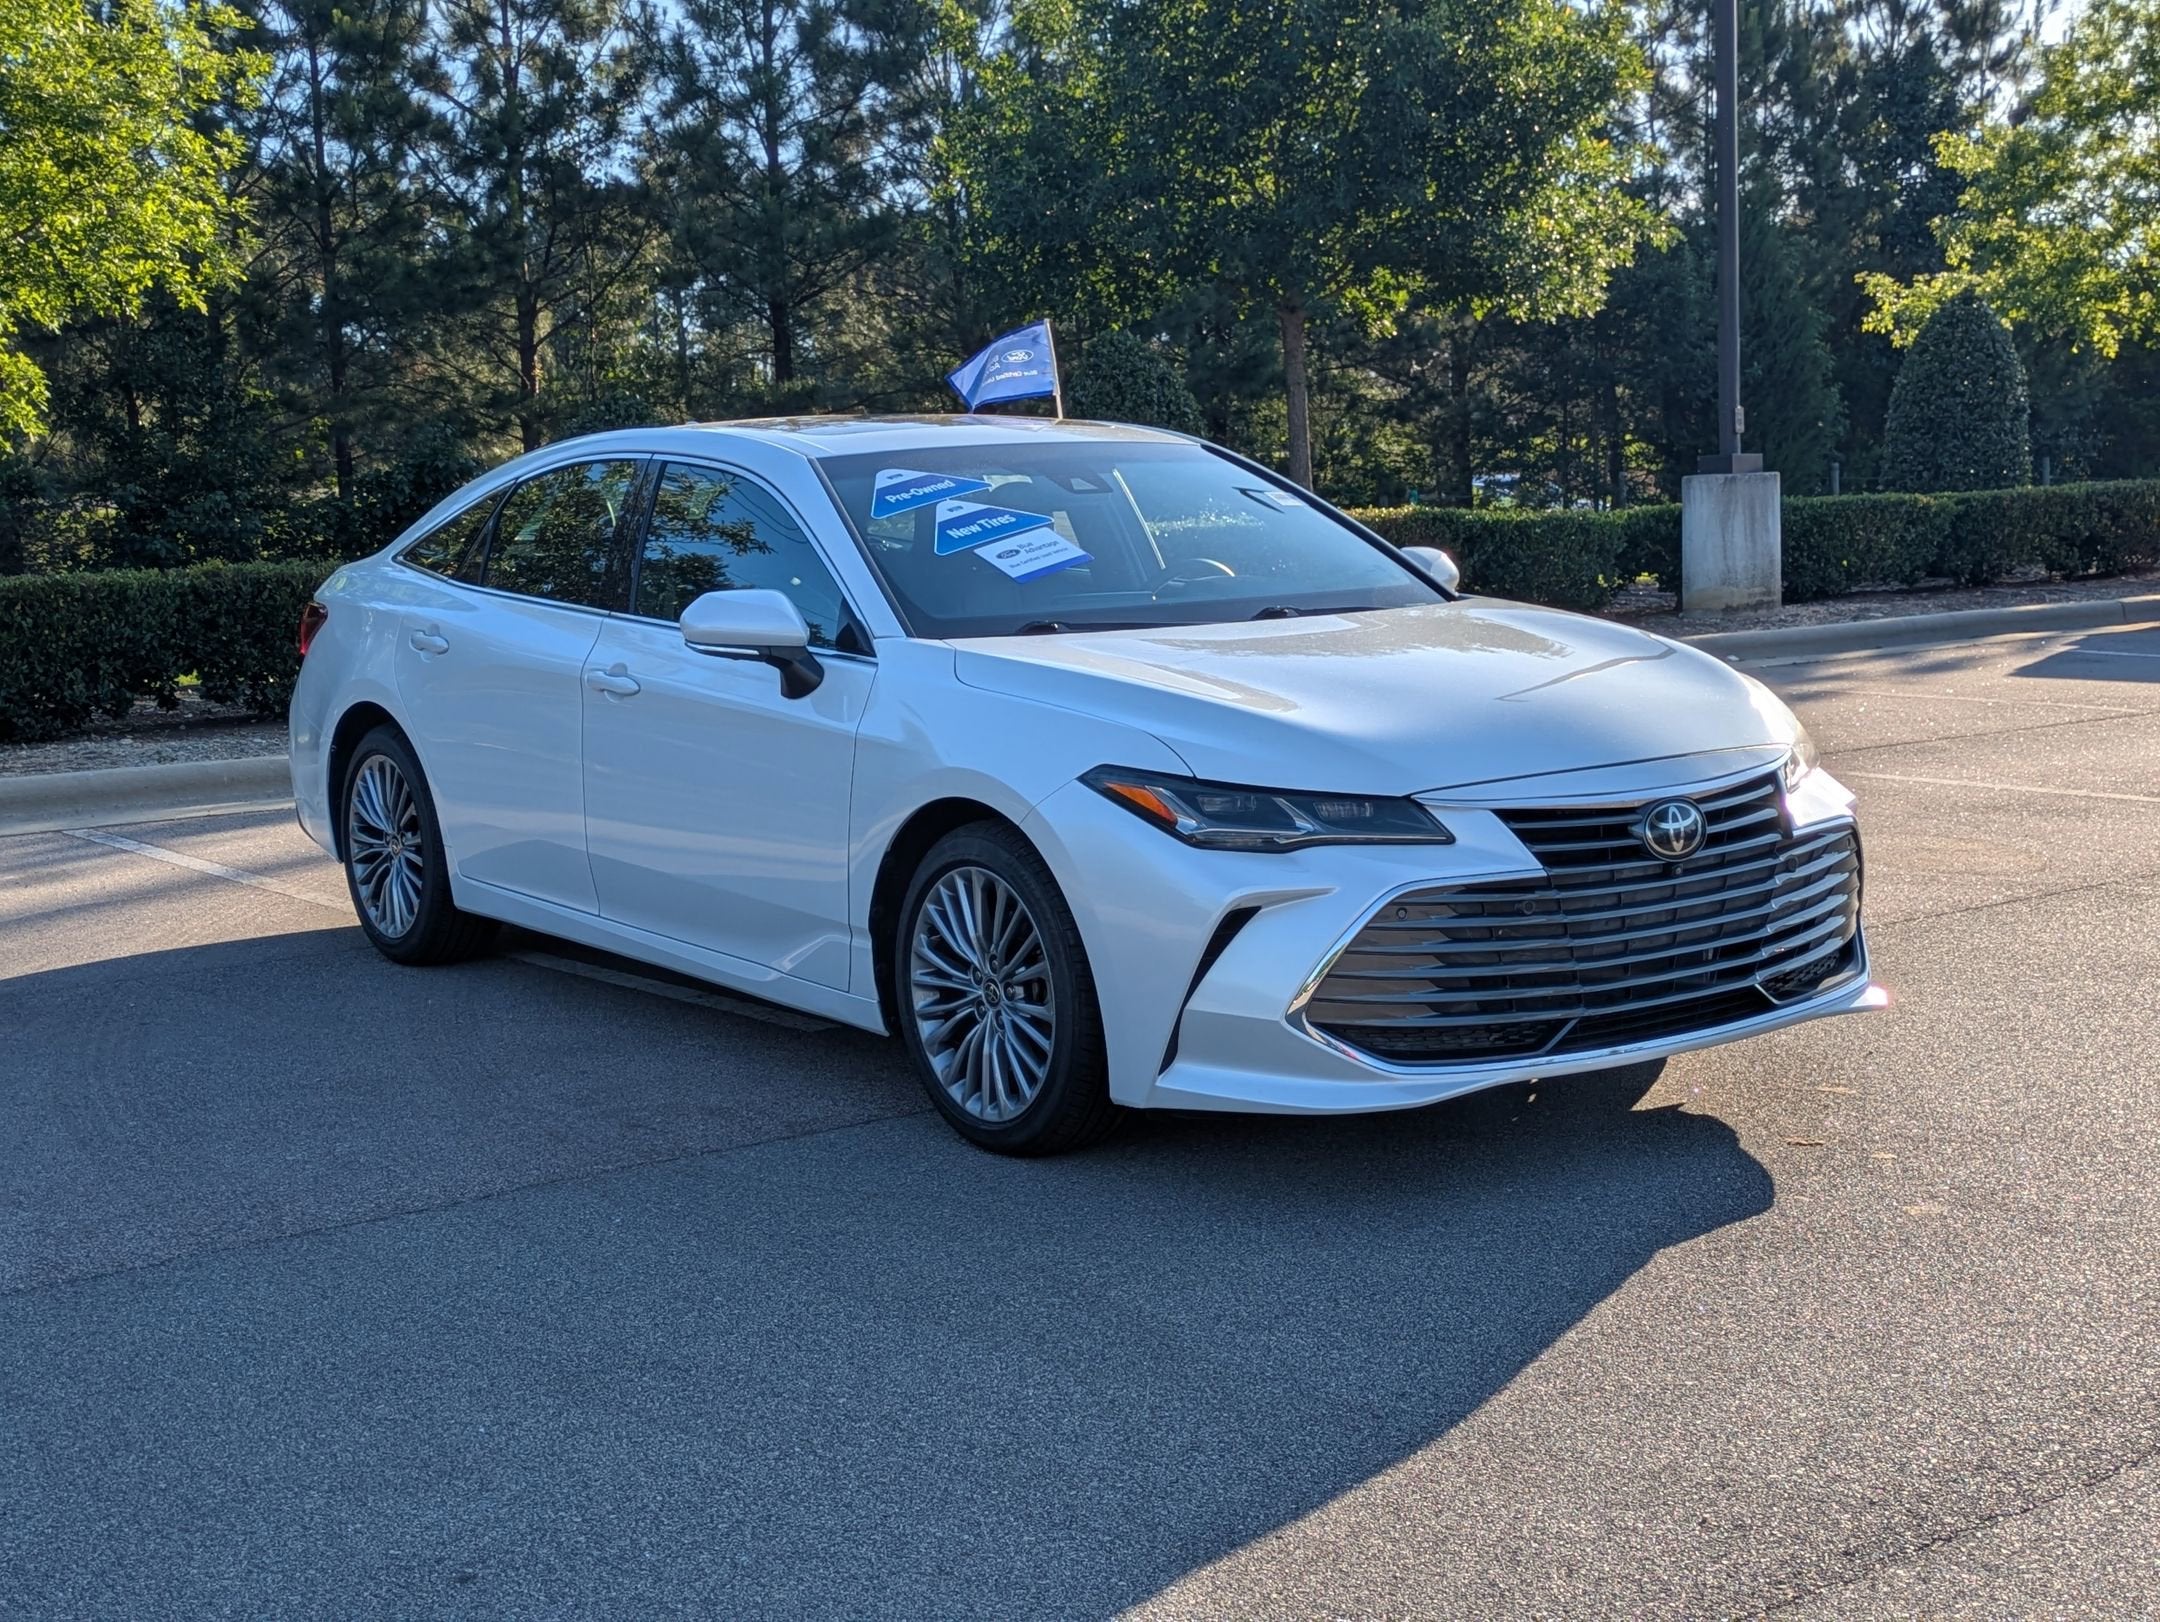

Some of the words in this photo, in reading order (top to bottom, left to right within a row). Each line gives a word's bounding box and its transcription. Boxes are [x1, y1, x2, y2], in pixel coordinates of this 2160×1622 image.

[885, 479, 956, 502] Pre-Owned
[946, 522, 981, 538] New
[976, 515, 1016, 530] Tires
